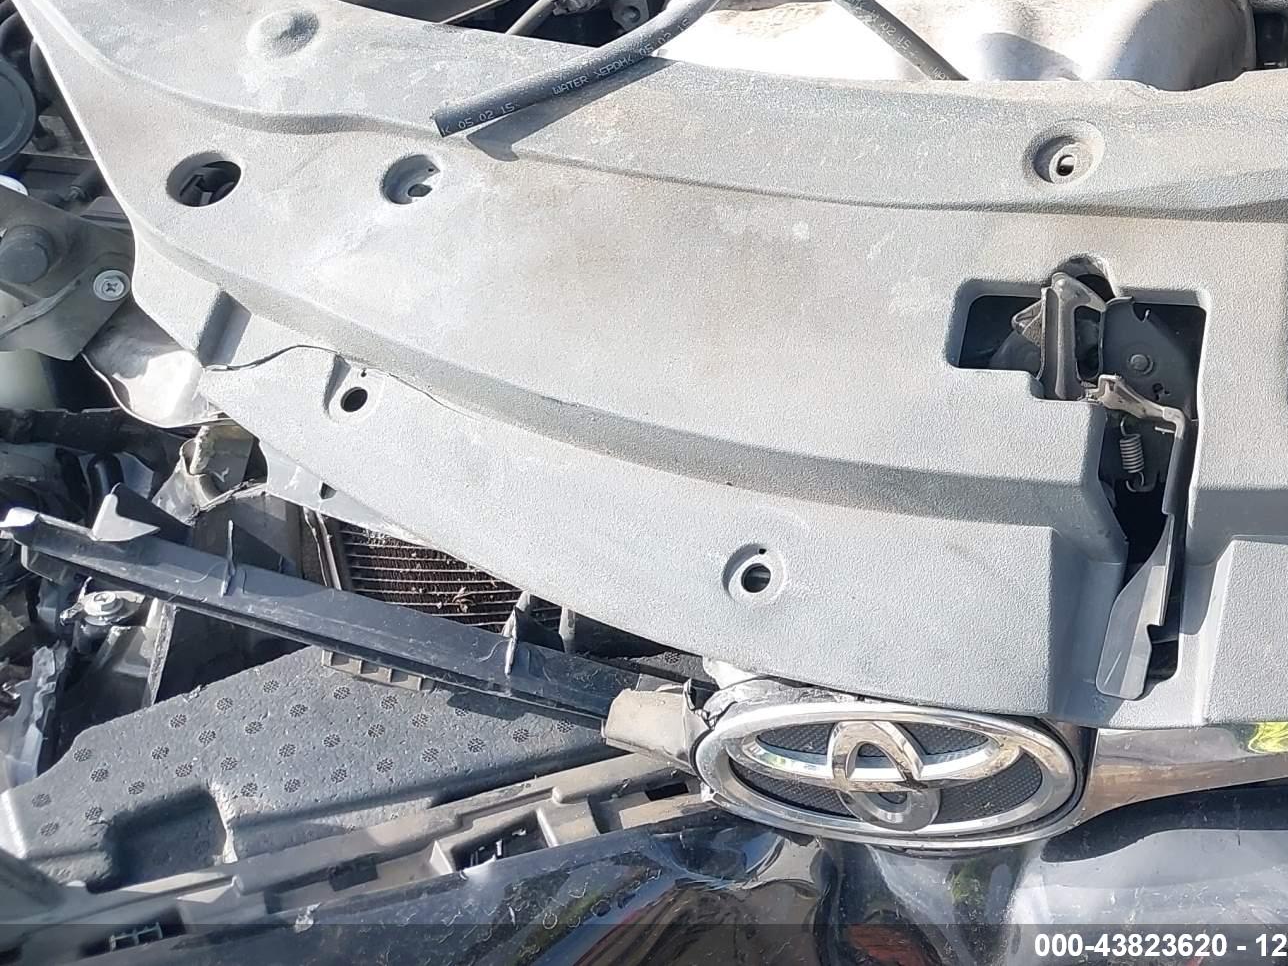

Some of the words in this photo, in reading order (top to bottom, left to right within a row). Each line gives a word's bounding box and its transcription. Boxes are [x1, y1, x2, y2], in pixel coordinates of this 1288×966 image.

[458, 117, 474, 129] 05
[478, 110, 494, 121] 02
[500, 102, 516, 115] 15
[552, 75, 589, 95] WATER
